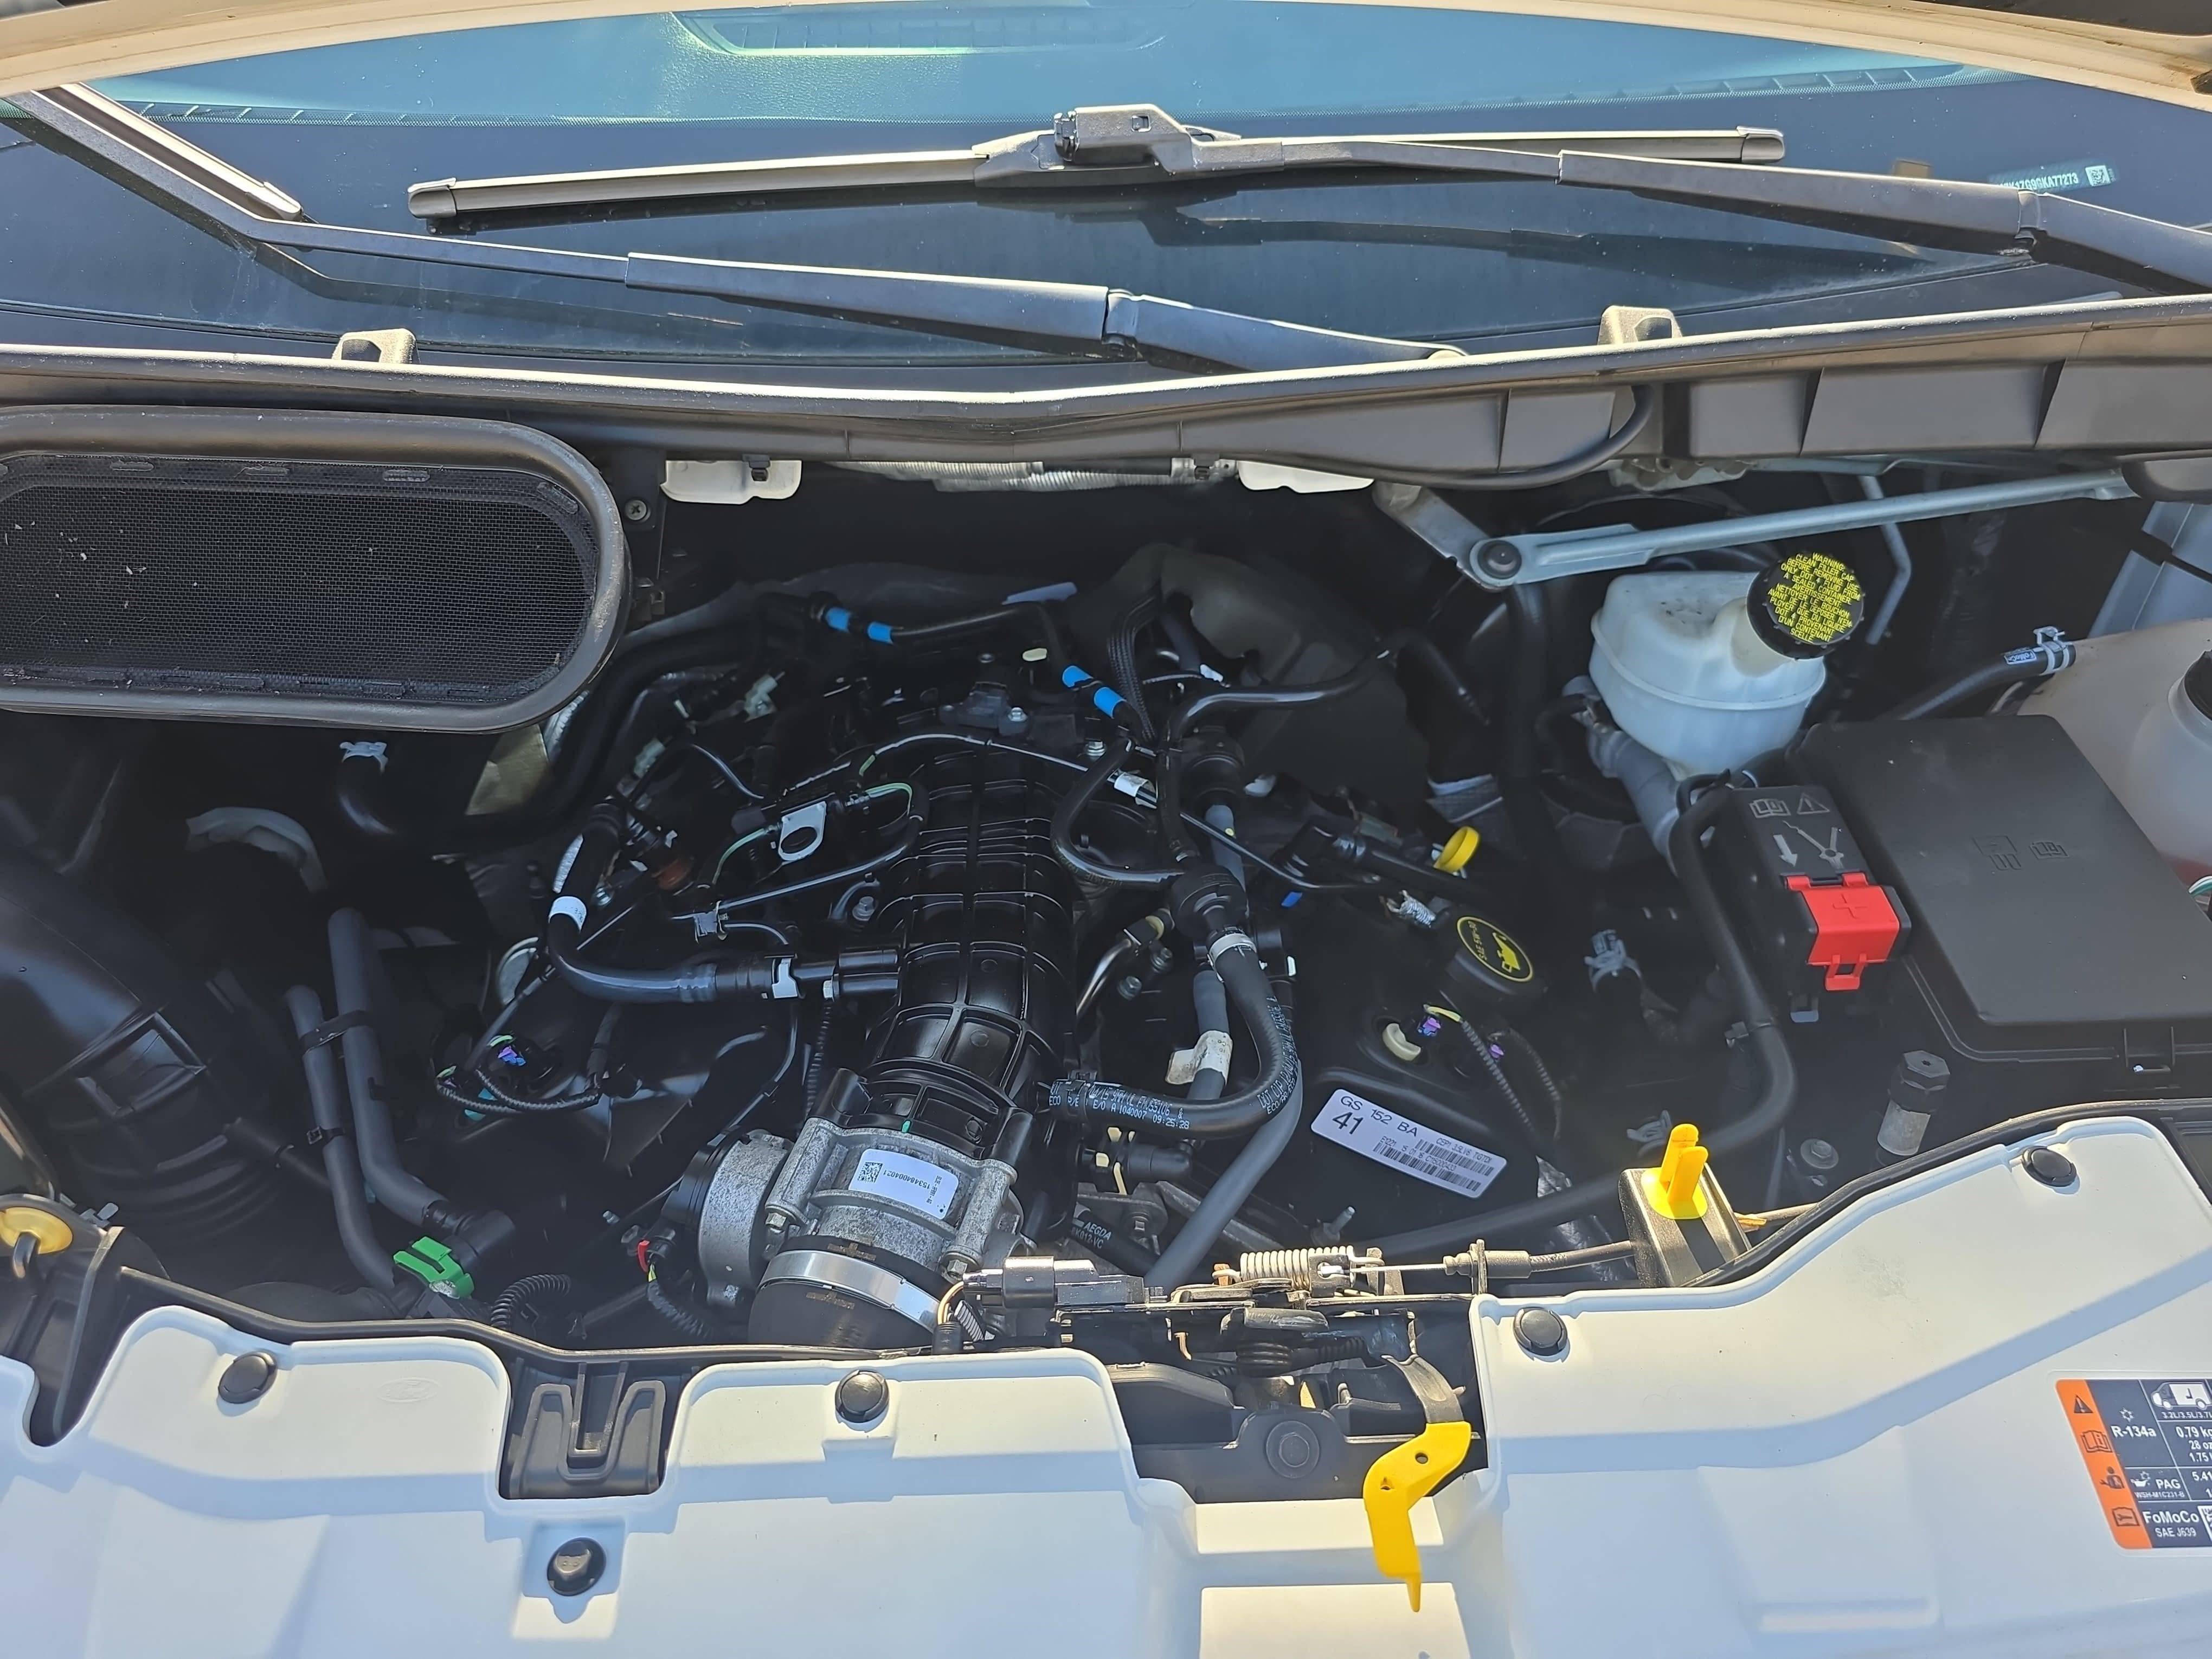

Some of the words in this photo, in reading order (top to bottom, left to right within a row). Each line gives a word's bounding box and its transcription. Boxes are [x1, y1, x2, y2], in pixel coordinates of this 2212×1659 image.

[1796, 554, 1816, 567] CLEAN
[1818, 563, 1839, 577] FILLER
[1812, 552, 1846, 572] WARNING:
[1780, 563, 1798, 574] ONLY
[1800, 570, 1815, 581] DOT
[1823, 580, 1841, 593] FLUID
[1843, 588, 1861, 601] FROM
[1787, 558, 1812, 573] BEFORE
[1847, 582, 1860, 594] USE
[1791, 575, 1816, 589] SEALED
[1767, 588, 1788, 601] AVANT
[1789, 596, 1799, 606] DE
[1799, 600, 1809, 609] LE
[1776, 583, 1808, 601] NETTOYER
[1810, 597, 1819, 607] LE
[1821, 602, 1850, 619] BOUCHON
[1770, 596, 1795, 612] PLOYER
[1796, 607, 1810, 618] QUE
[1811, 613, 1821, 622] DU
[1822, 618, 1847, 634] LIQUIDE
[1774, 606, 1790, 617] DOT
[1798, 615, 1835, 636] PROVENANT
[1795, 622, 1833, 642] CONTENANT
[1332, 1111, 1364, 1135] 41
[1340, 1096, 1363, 1111] GS
[1370, 1109, 1393, 1125] 152
[1397, 1121, 1418, 1137] BA
[1083, 1221, 1112, 1241] AEGDA
[2110, 1425, 2157, 1438] R-134a
[2175, 1426, 2200, 1438] 0.79
[2188, 1439, 2201, 1450] 28
[2189, 1452, 2209, 1462] 1.75
[2155, 1478, 2181, 1489] PAG
[2142, 1510, 2200, 1524] FoMoCo
[2155, 1527, 2176, 1538] SAE
[2176, 1527, 2196, 1537] J639
